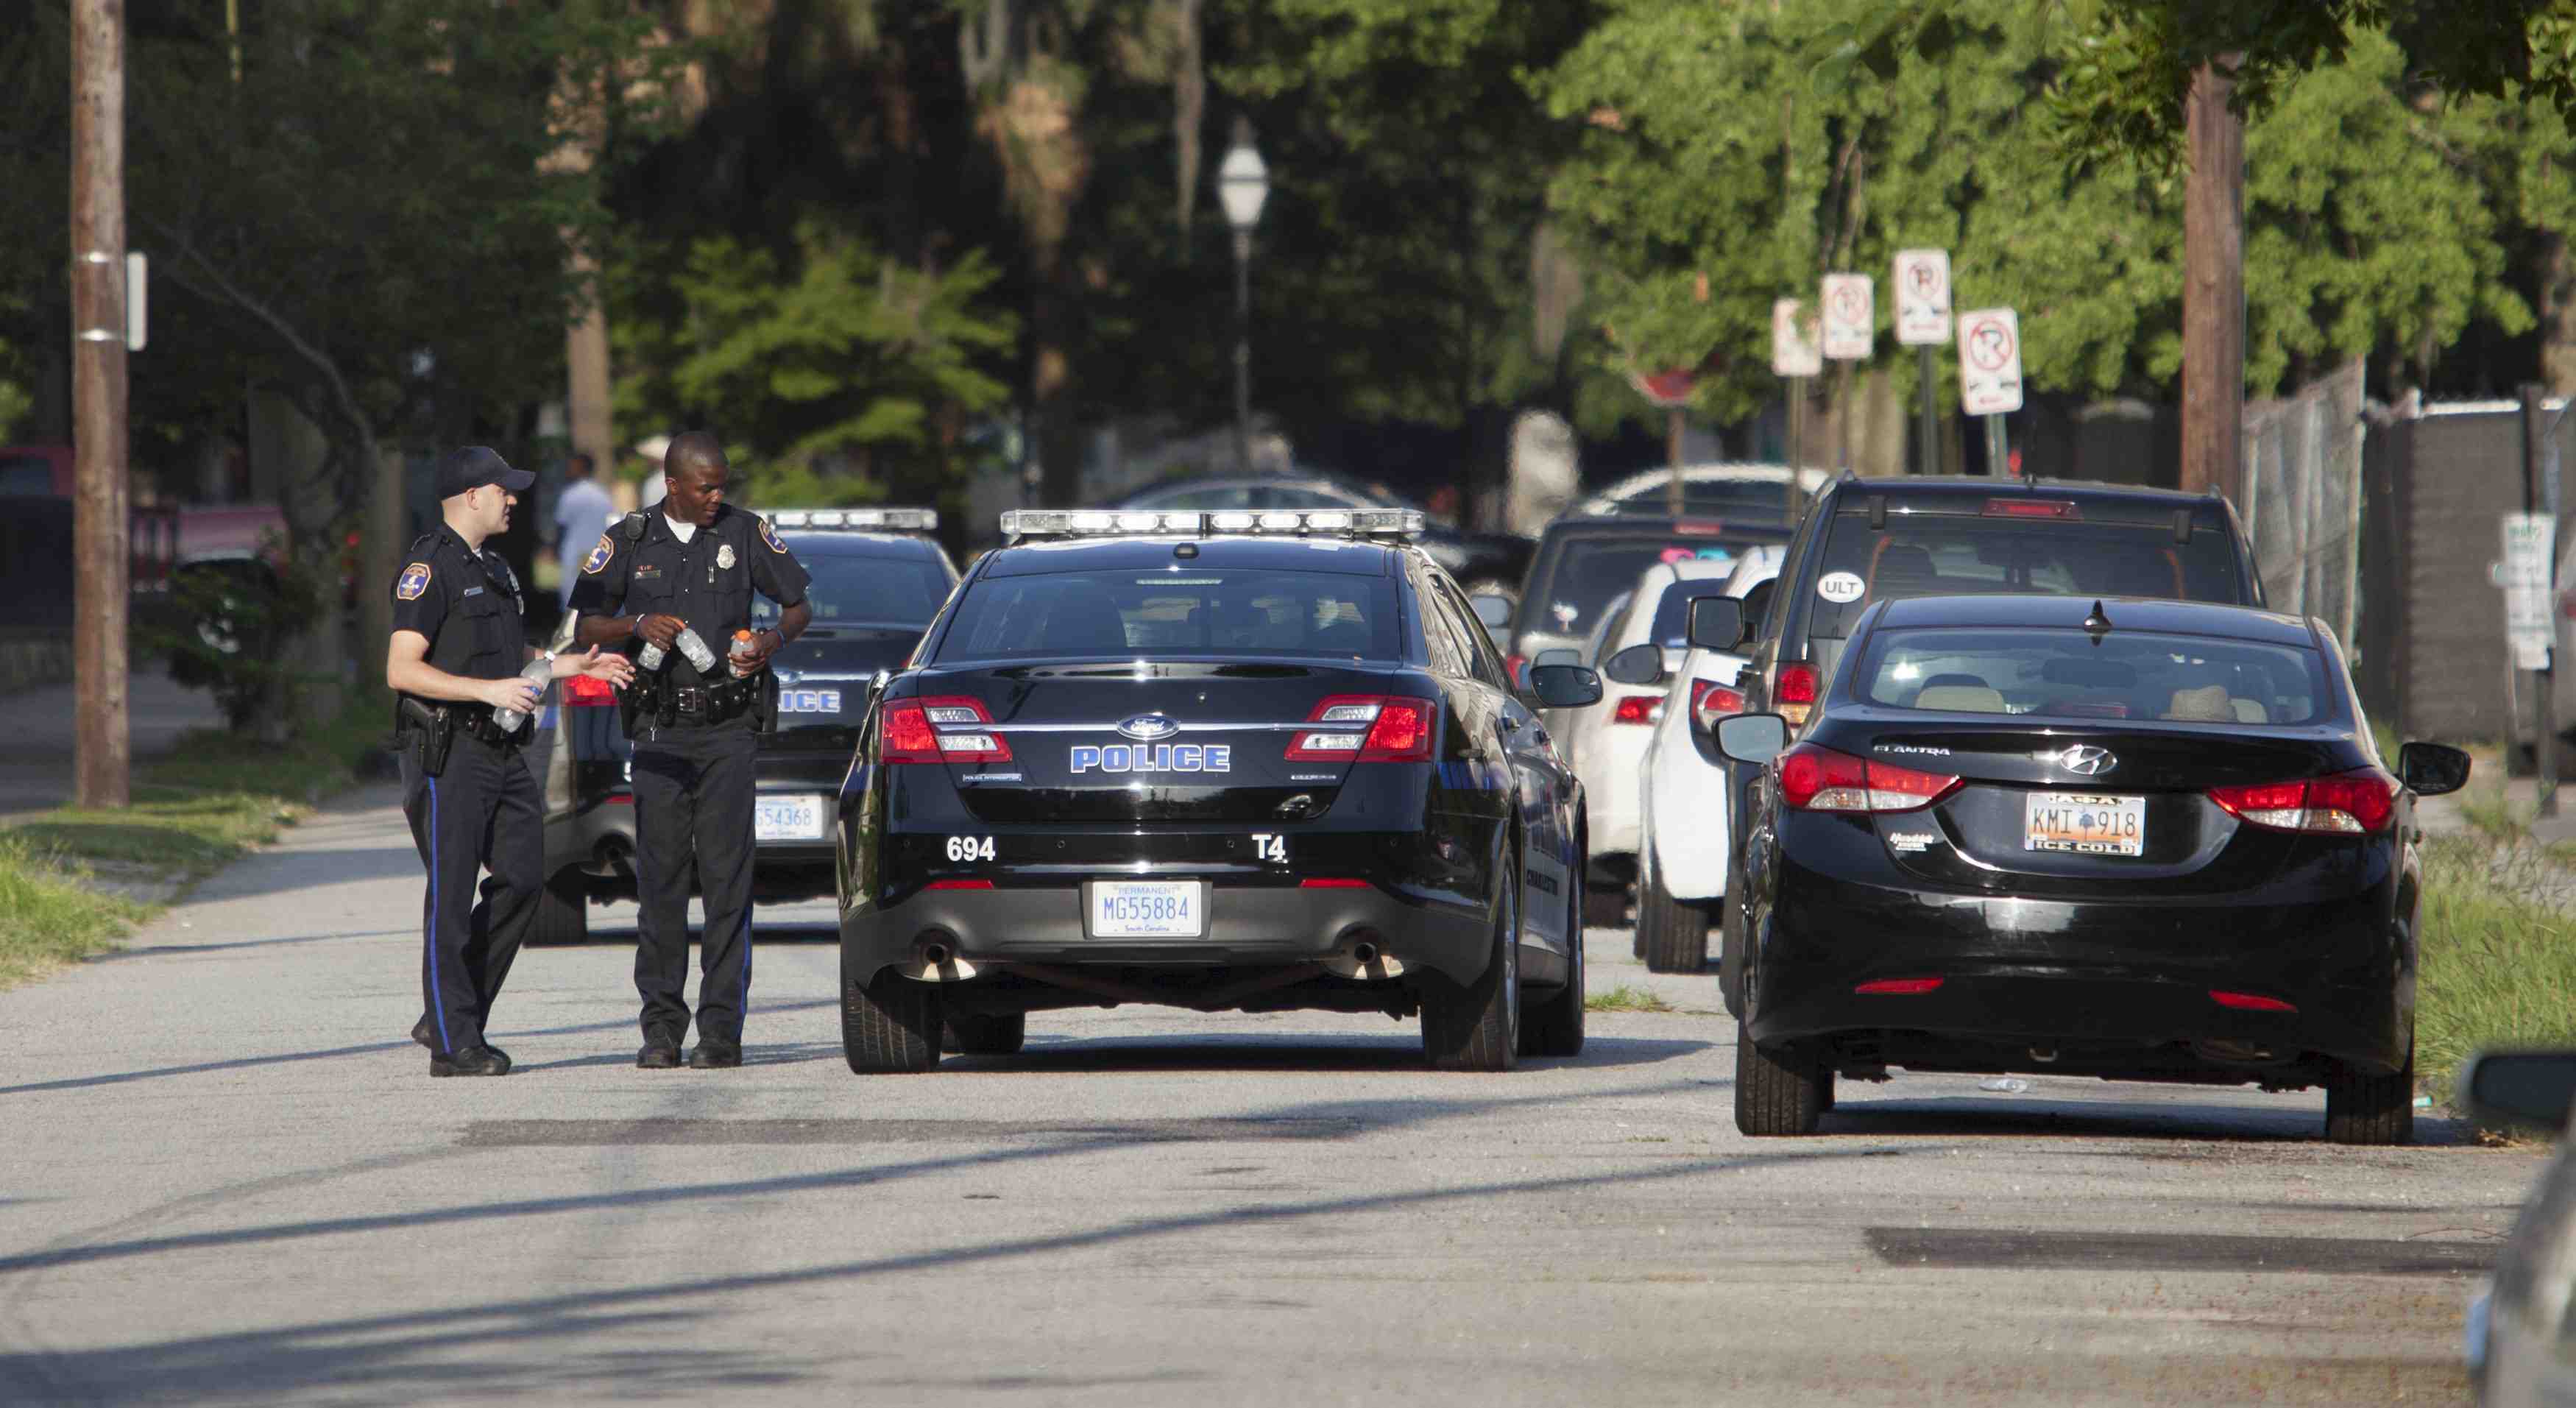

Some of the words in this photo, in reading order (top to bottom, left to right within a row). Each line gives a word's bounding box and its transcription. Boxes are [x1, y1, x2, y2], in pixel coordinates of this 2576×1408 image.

[1825, 581, 1858, 594] ULT
[778, 690, 841, 712] ICE
[1130, 718, 1165, 733] Ford
[1071, 744, 1231, 774] POLICE
[2034, 808, 2073, 833] KMI
[2098, 811, 2136, 836] 918
[946, 836, 996, 861] 694
[1251, 833, 1286, 860] T4
[2035, 841, 2071, 851] ICE
[2076, 843, 2135, 854] COLD
[1103, 896, 1189, 920] MG55884
